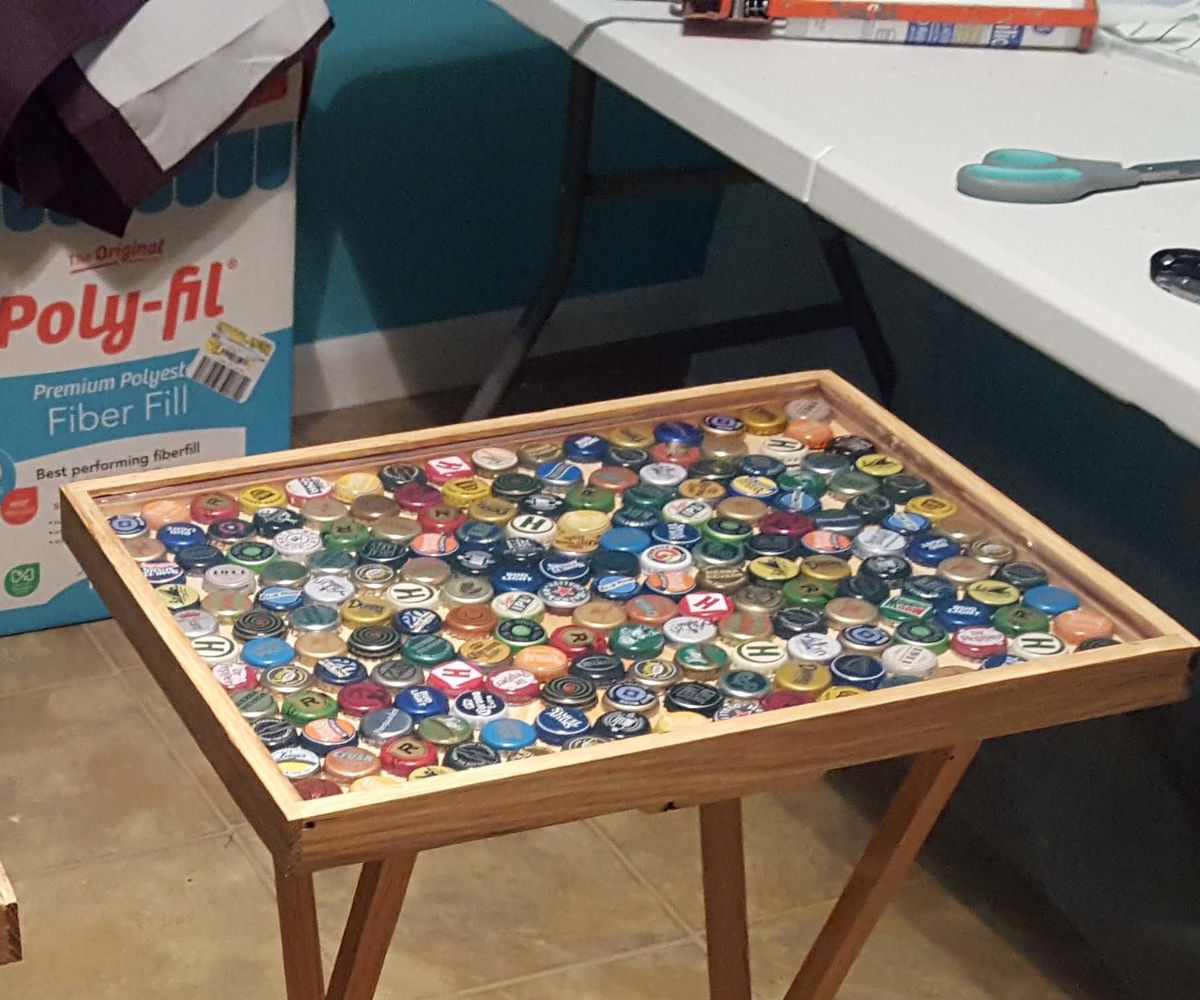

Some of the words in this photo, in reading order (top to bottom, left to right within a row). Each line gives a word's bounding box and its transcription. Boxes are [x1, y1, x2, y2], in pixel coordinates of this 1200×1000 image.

[96, 239, 167, 263] Original
[33, 377, 115, 400] Premium
[120, 361, 187, 388] Polyest
[48, 402, 134, 436] Fiber
[145, 384, 188, 421] Fill
[36, 467, 67, 480] Best
[72, 455, 149, 478] performing
[153, 442, 200, 461] fiberfill
